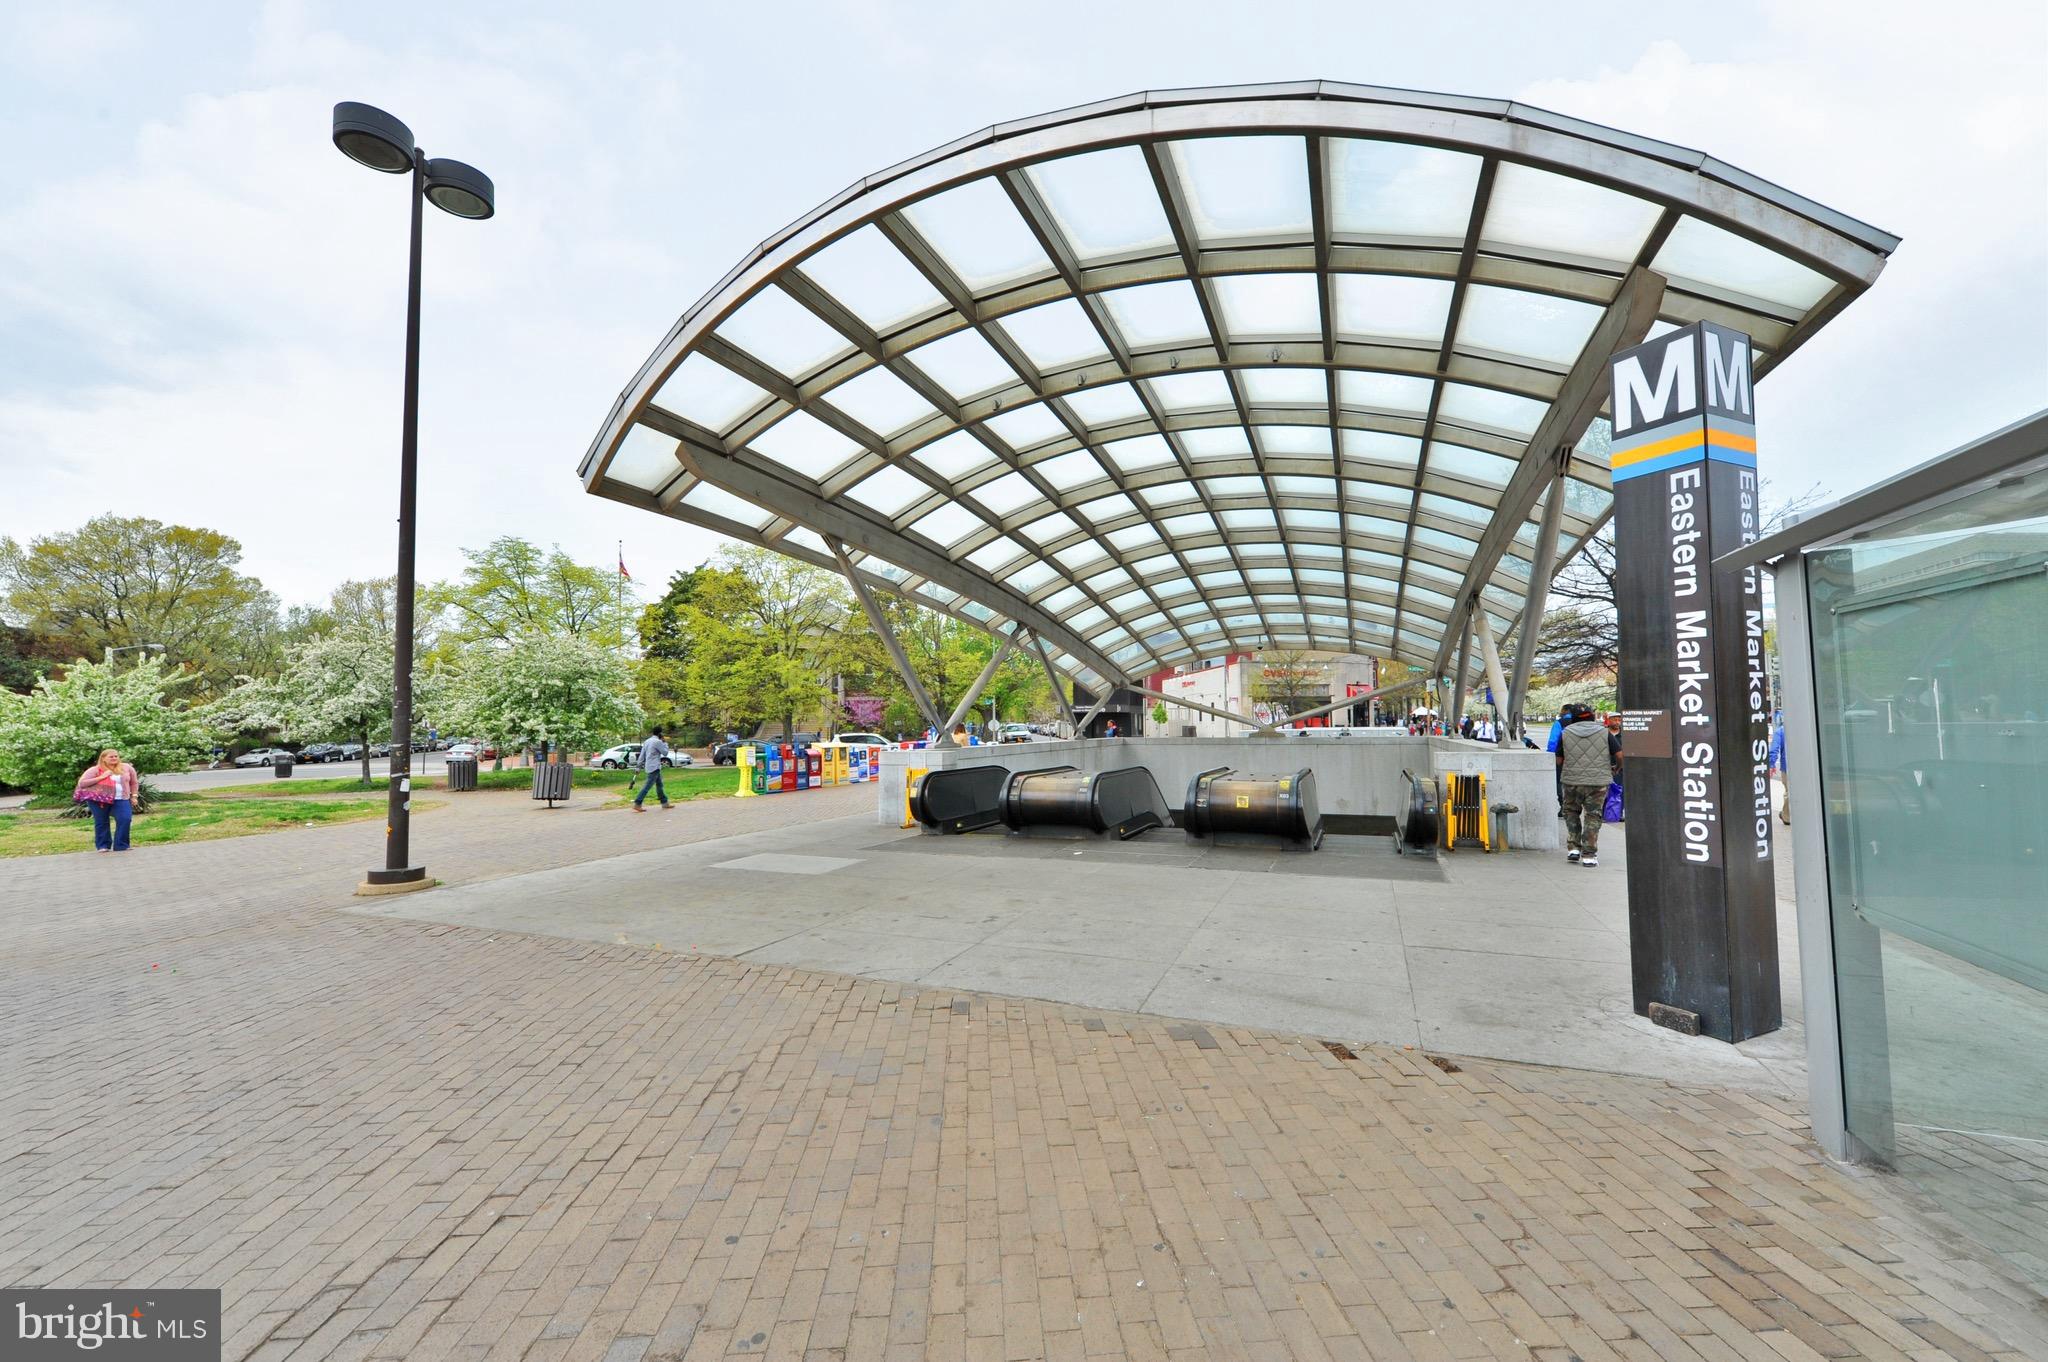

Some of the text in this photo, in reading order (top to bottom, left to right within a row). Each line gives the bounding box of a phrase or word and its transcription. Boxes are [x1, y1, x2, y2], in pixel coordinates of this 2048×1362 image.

[1613, 334, 1697, 433] M
[1704, 331, 1751, 416] M
[1670, 467, 1716, 862] Eastern Market Station
[1739, 470, 1771, 858] Eastrn Market Station
